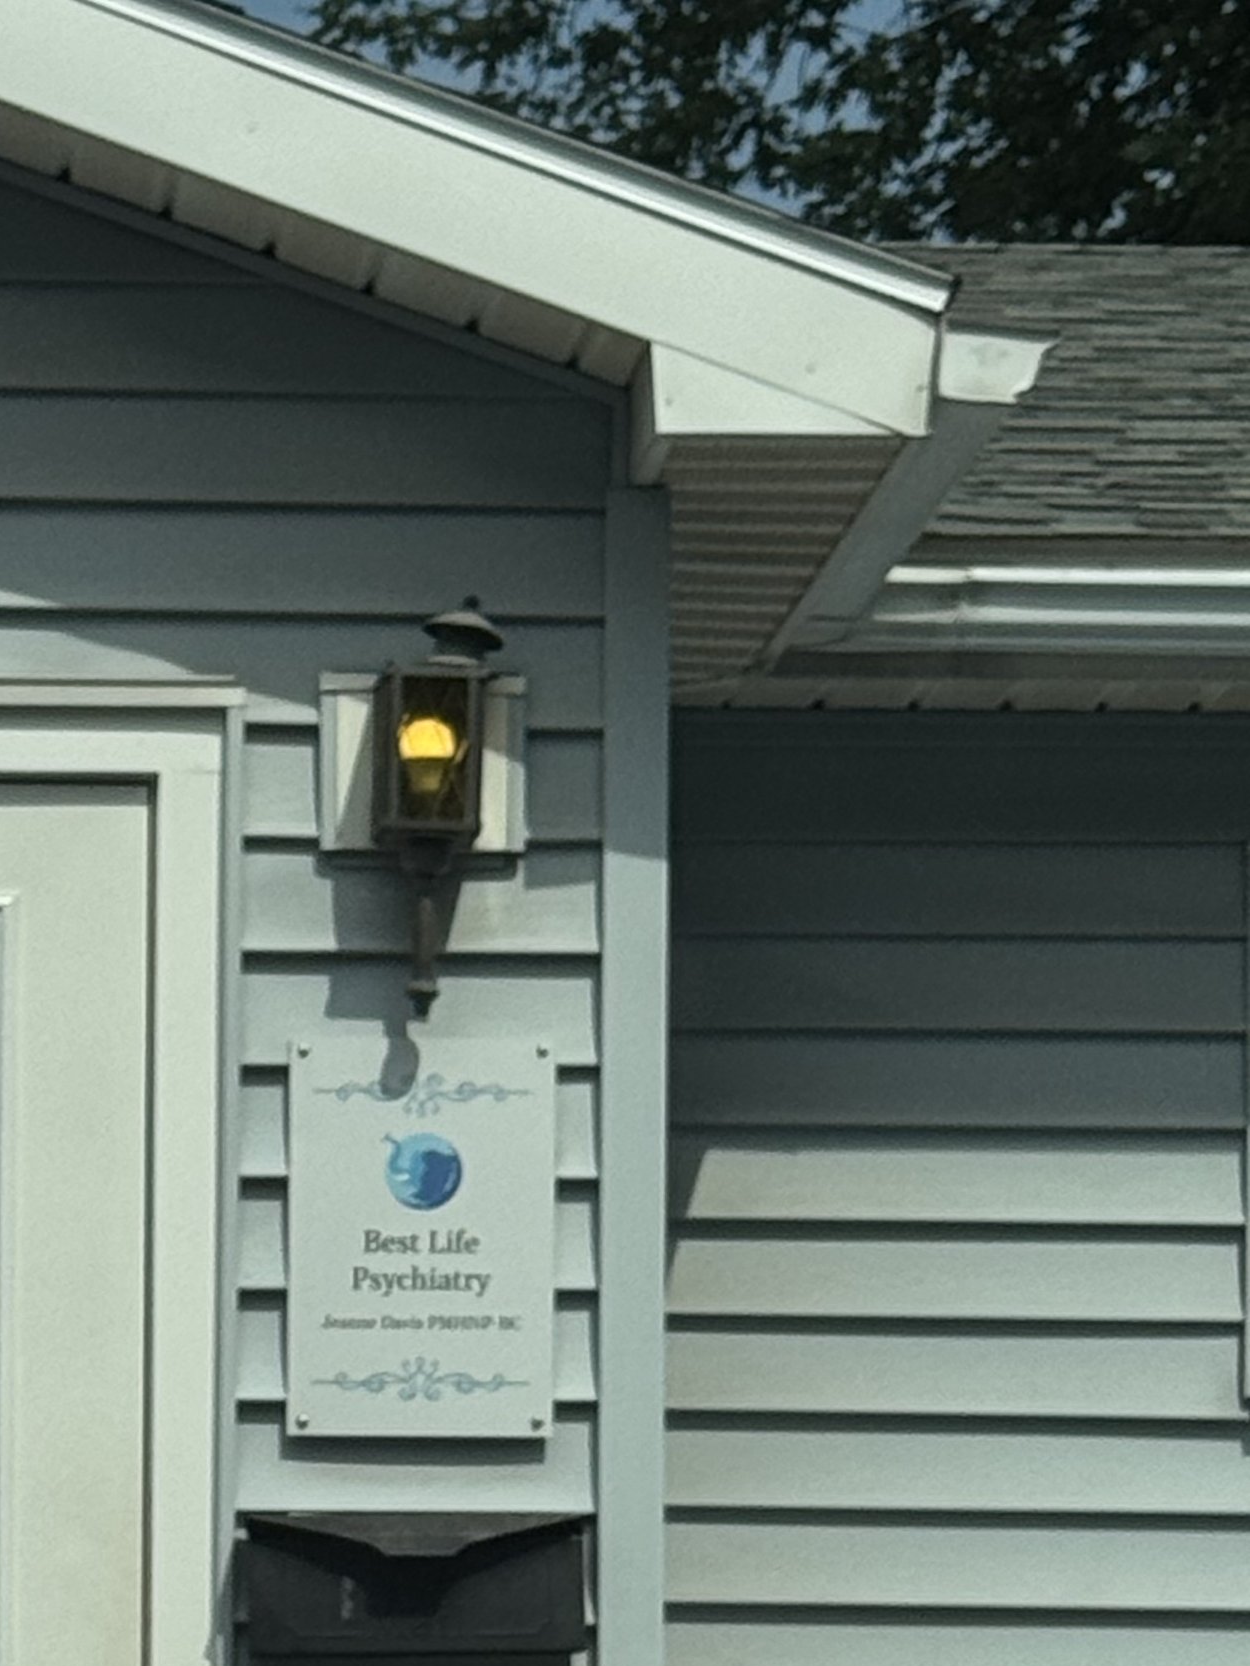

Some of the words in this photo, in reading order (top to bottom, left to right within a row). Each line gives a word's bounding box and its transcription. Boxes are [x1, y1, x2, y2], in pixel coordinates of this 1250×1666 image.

[363, 1229, 420, 1254] Best
[429, 1228, 481, 1254] Life
[352, 1265, 492, 1298] Psychiatry
